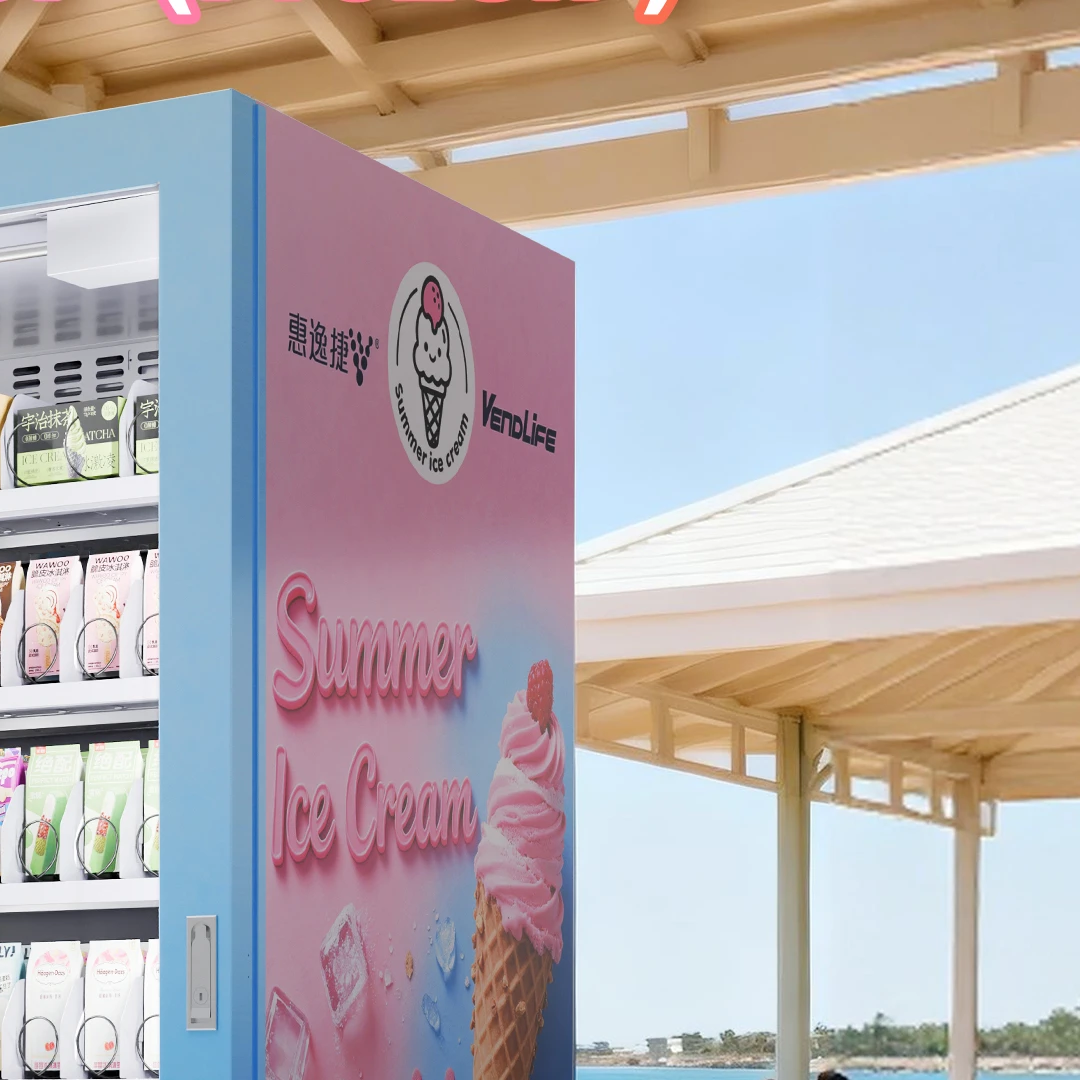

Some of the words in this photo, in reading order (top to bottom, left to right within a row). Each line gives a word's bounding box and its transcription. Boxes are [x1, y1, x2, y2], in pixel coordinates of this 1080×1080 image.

[288, 312, 349, 373] 惠逸捷
[83, 428, 116, 441] ATCHA
[395, 383, 428, 465] Summer
[429, 451, 443, 472] ice
[446, 413, 469, 467] cream
[35, 560, 70, 569] WAWOO
[95, 555, 130, 564] WAWOO
[272, 571, 478, 710] Summer
[272, 745, 336, 867] Ice
[345, 742, 478, 864] Cream
